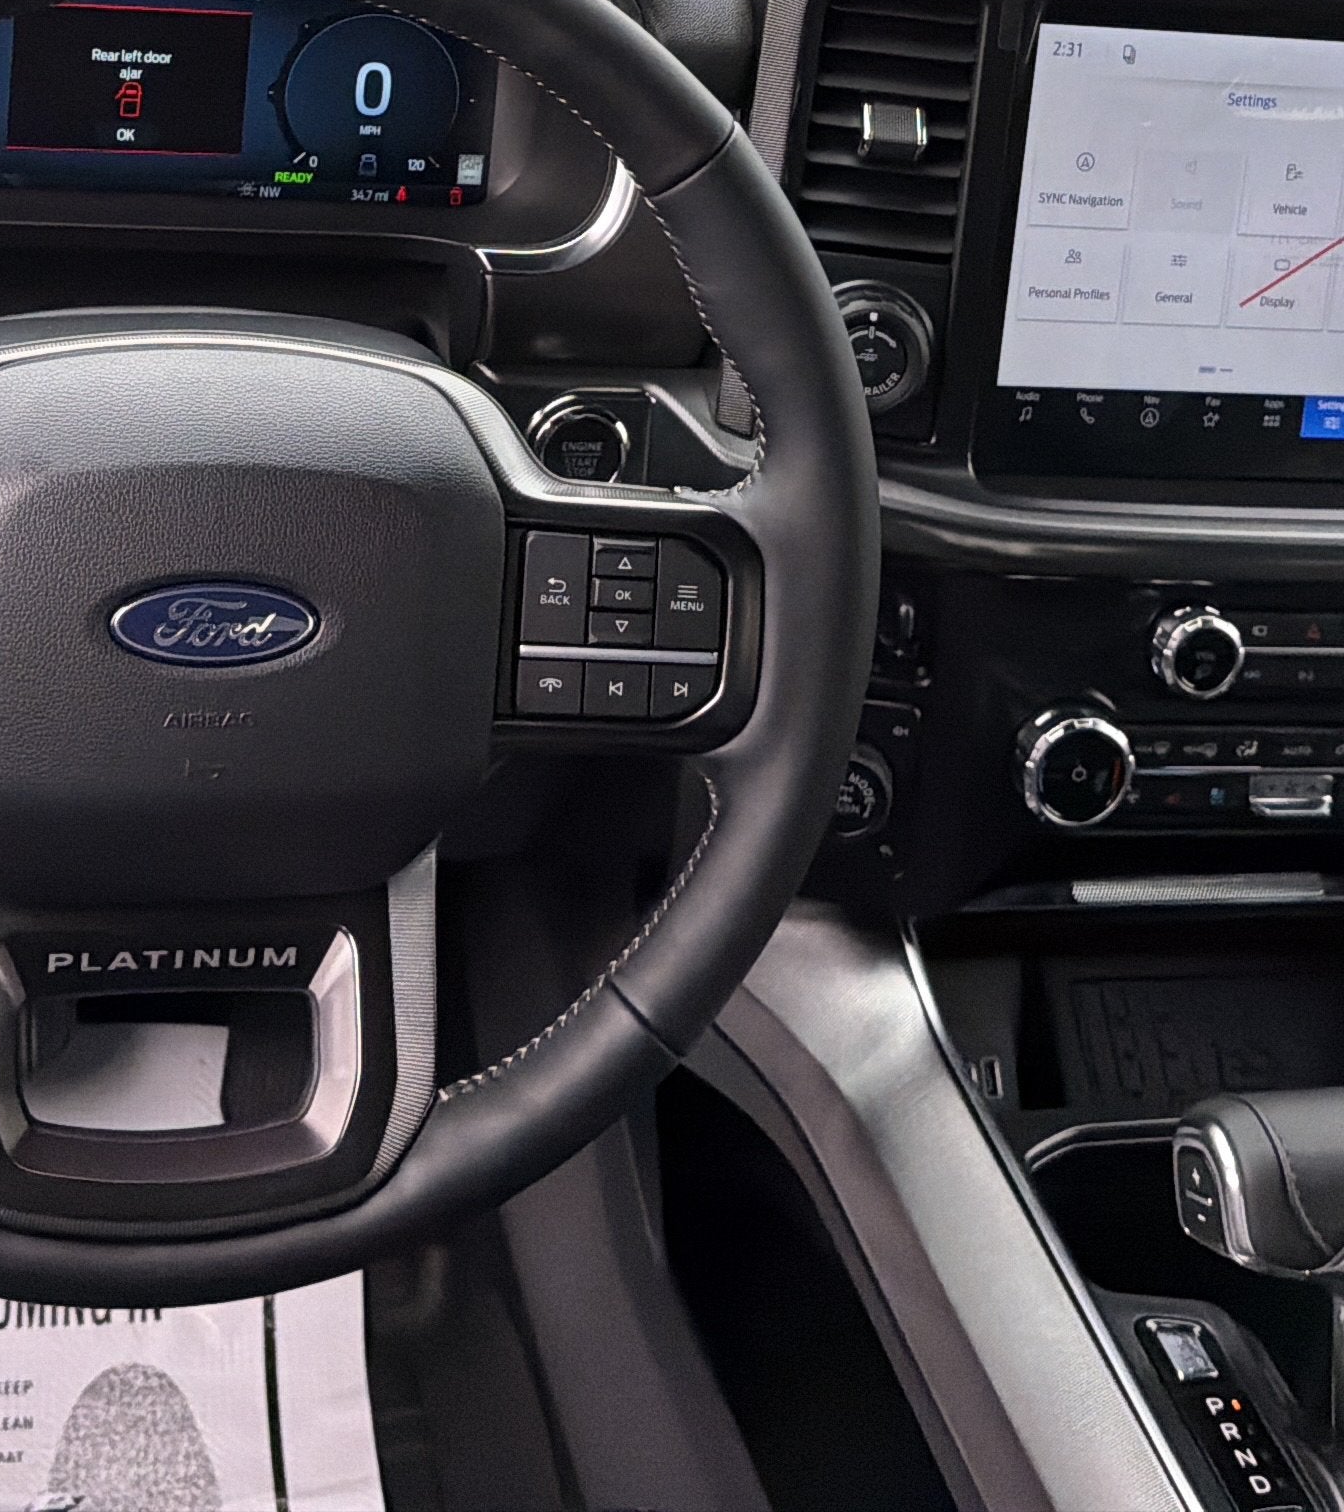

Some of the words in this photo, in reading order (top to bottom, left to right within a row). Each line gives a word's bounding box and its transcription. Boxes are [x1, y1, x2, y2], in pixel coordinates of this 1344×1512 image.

[1053, 41, 1083, 57] 2:31
[92, 48, 120, 62] Rear
[121, 50, 143, 64] left
[144, 51, 172, 65] door
[119, 67, 143, 80] ajar
[355, 61, 393, 116] 0
[1227, 92, 1278, 109] Settings
[116, 129, 135, 141] OK
[359, 125, 381, 136] MPH
[309, 156, 318, 168] 0
[407, 158, 425, 171] 120
[274, 172, 314, 183] READY
[259, 187, 281, 198] NW
[1038, 192, 1067, 205] SYNC
[1069, 193, 1123, 208] Navigation
[1273, 203, 1308, 216] Vehicle
[1028, 287, 1071, 299] Personal
[1073, 288, 1110, 301] Profiles
[1155, 292, 1193, 304] General
[1259, 296, 1295, 309] Display
[864, 372, 901, 396] RAILER
[540, 594, 570, 605] BACK
[615, 590, 632, 600] OK
[670, 600, 704, 612] MENU
[153, 597, 277, 647] Ford
[47, 946, 300, 973] PLATINUM
[1206, 1397, 1224, 1416] P
[1219, 1422, 1242, 1441] R
[1233, 1447, 1258, 1468] N
[1249, 1475, 1271, 1494] D
